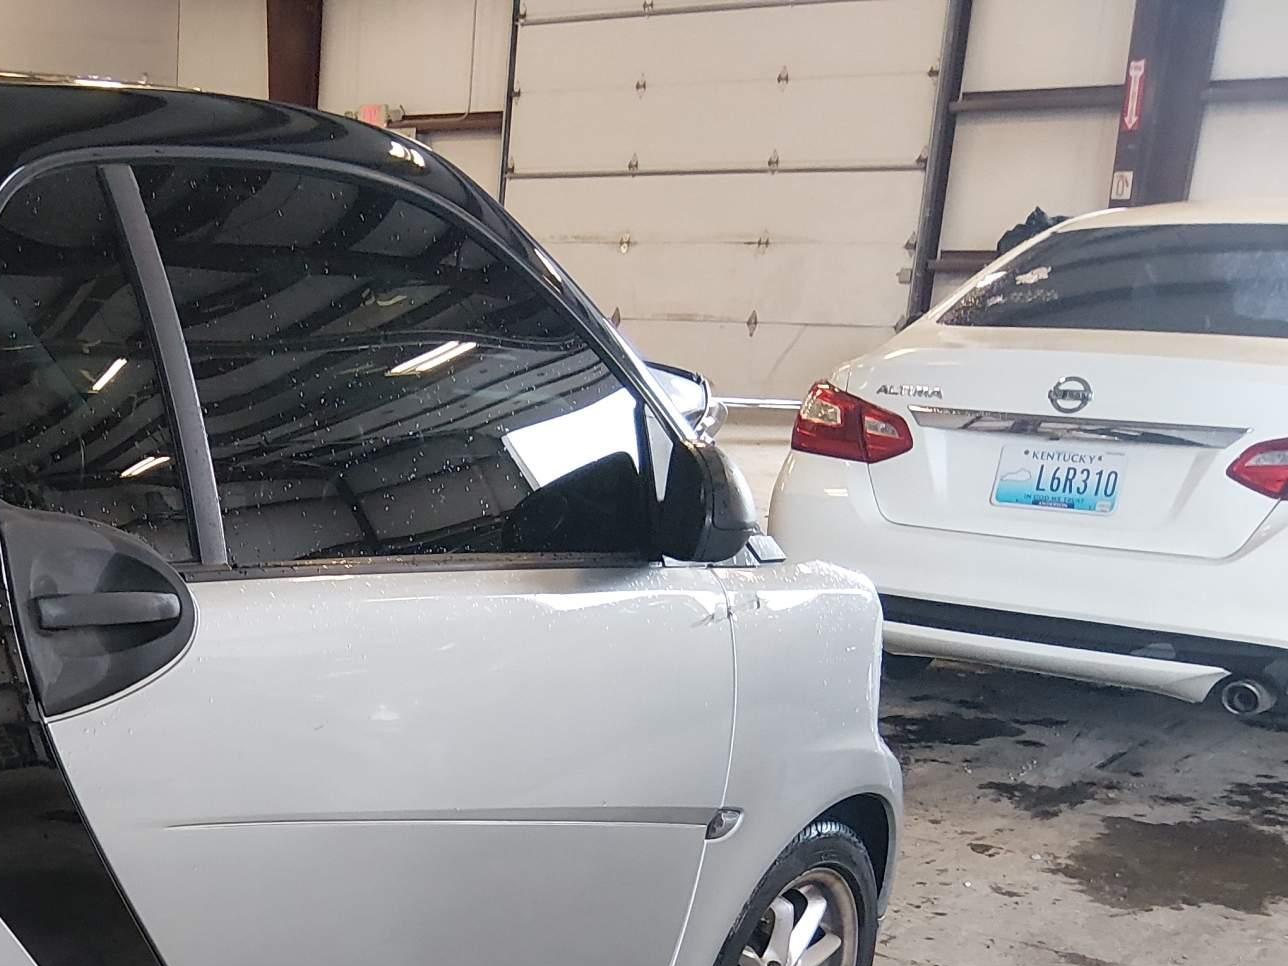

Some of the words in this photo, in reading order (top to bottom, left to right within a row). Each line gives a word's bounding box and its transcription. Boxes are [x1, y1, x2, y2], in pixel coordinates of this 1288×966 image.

[875, 384, 943, 400] ALTIMA
[1032, 450, 1096, 465] KENTUCKY
[1035, 464, 1119, 498] L6R310
